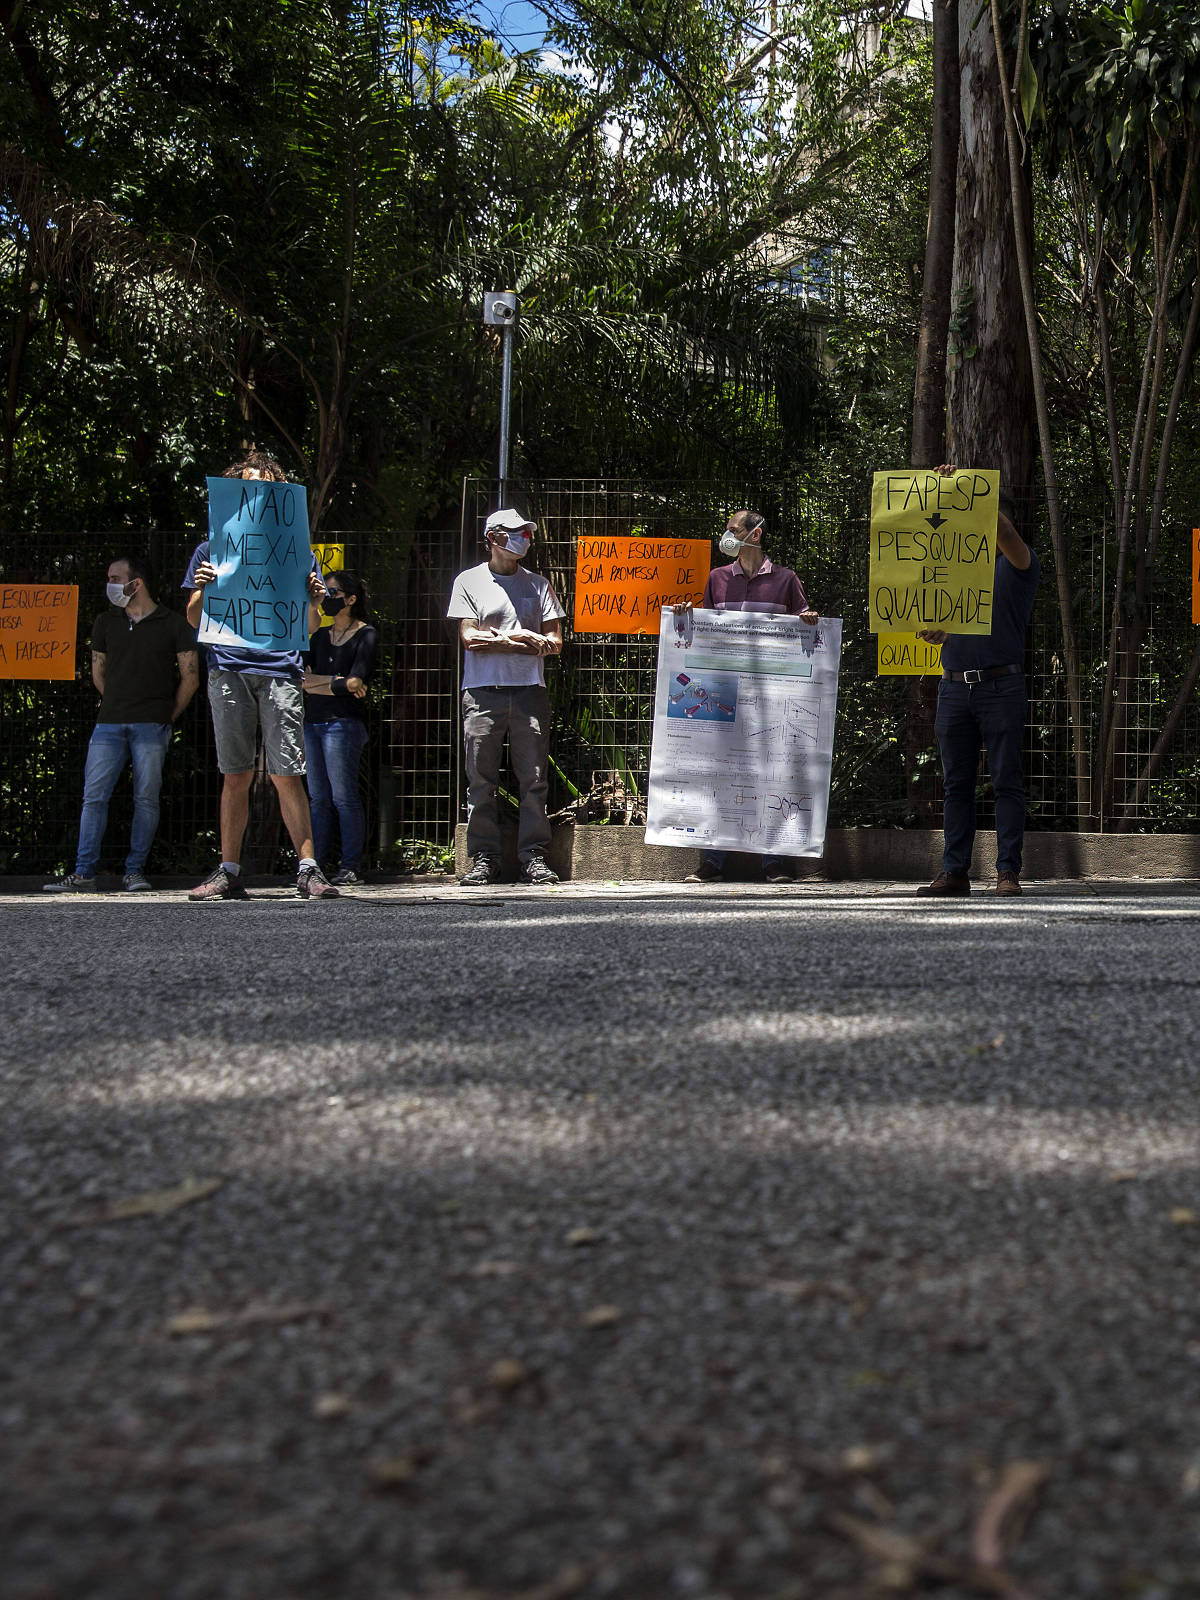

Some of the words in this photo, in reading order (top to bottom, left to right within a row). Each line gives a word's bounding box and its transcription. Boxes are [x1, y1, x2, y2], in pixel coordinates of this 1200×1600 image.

[887, 475, 991, 511] FAPESP
[238, 483, 296, 527] NÃO
[225, 532, 299, 568] MEXA
[628, 542, 692, 560] ESQUECEU
[878, 531, 990, 564] PESQUISA
[246, 575, 277, 592] NA
[581, 564, 604, 584] SUA
[610, 565, 660, 581] PROMESSA
[676, 567, 696, 585] DE
[923, 566, 948, 584] DE
[2, 588, 71, 609] ESQUECEU
[581, 594, 627, 617] APOIAR
[630, 596, 641, 617] A
[875, 586, 991, 626] QUALIDADE
[38, 616, 57, 632] DE
[205, 596, 308, 642] FAPESP!
[16, 640, 71, 661] FAPESP?
